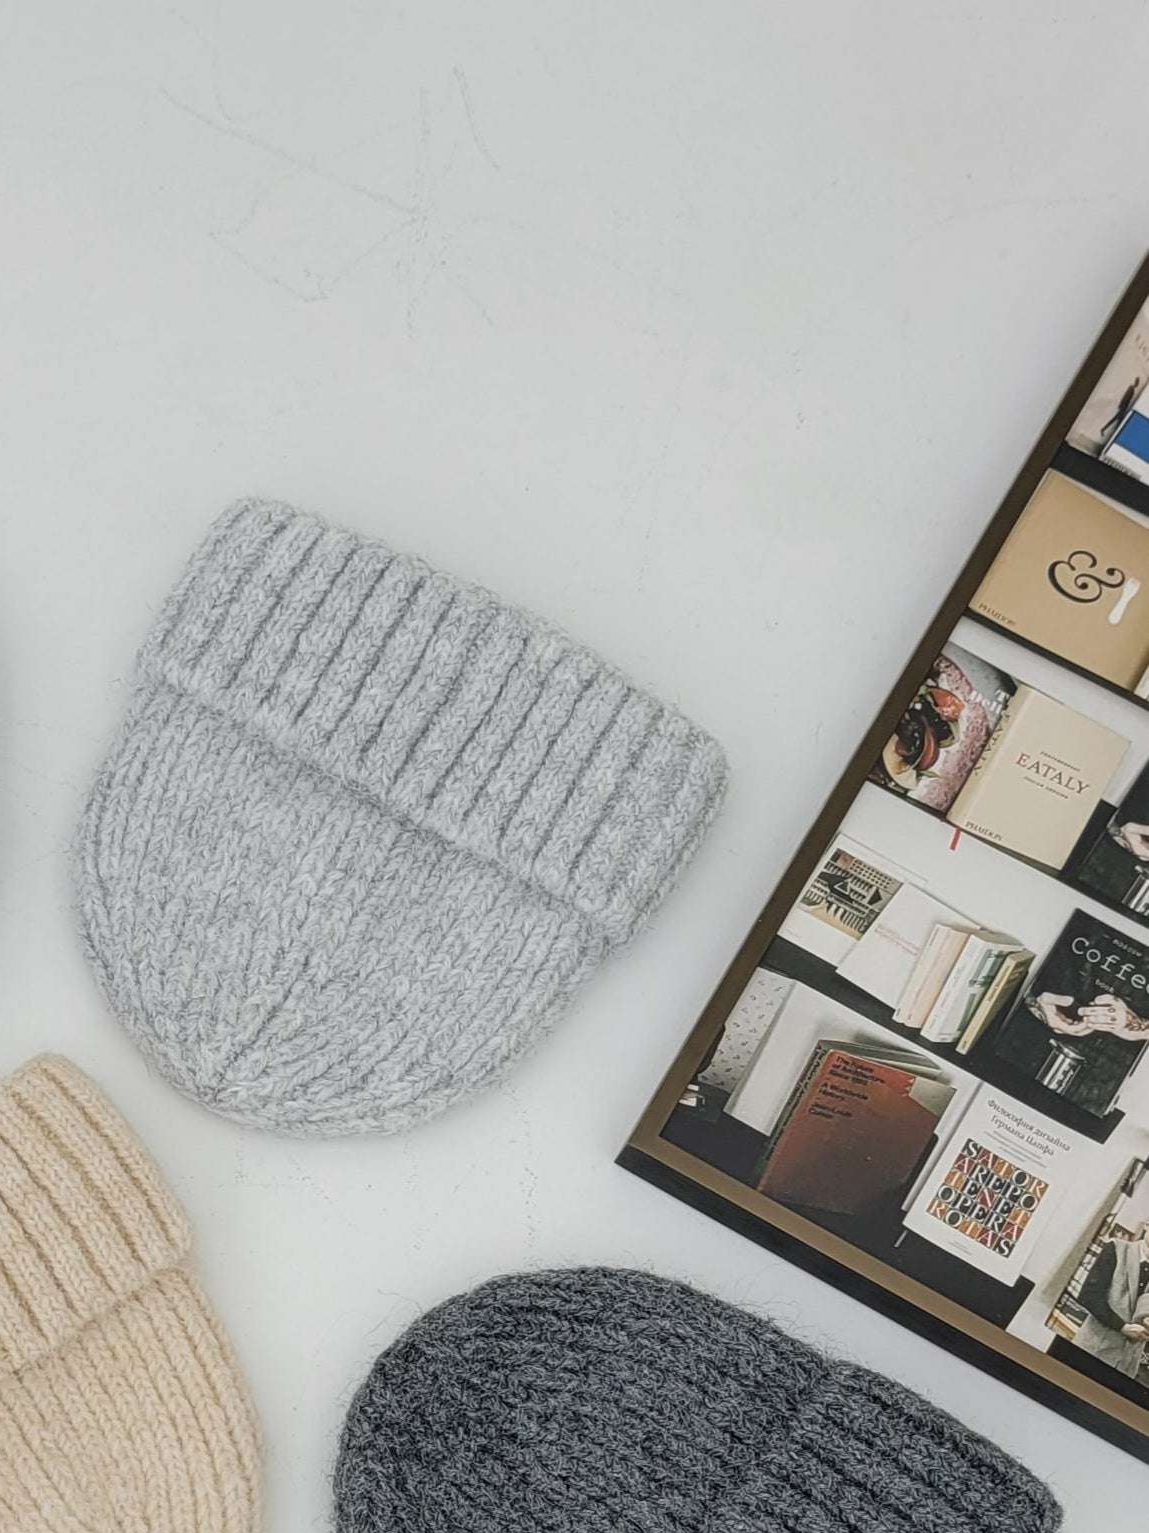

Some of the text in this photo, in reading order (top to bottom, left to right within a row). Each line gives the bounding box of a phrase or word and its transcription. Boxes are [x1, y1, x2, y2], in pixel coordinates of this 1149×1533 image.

[1015, 752, 1090, 795] EATALY
[1071, 936, 1149, 997] Coffe
[965, 1140, 1049, 1198] SATOR
[929, 1198, 1012, 1257] ROTAS
[937, 1184, 1022, 1241] OPERA
